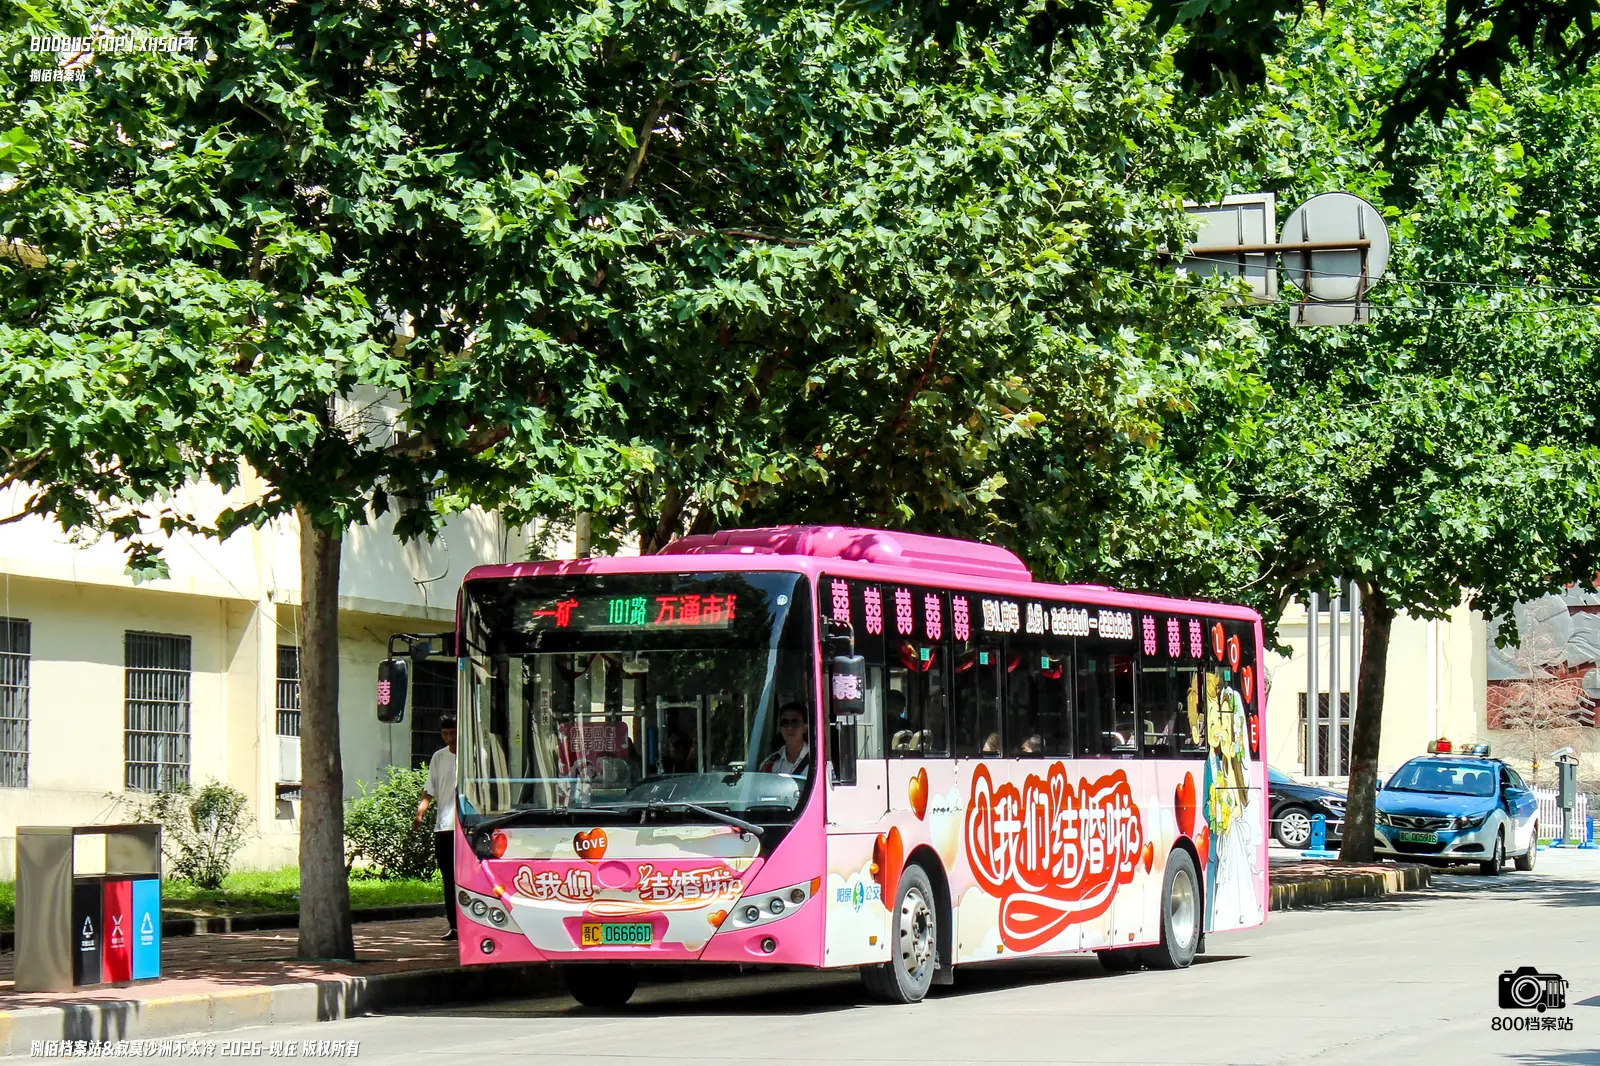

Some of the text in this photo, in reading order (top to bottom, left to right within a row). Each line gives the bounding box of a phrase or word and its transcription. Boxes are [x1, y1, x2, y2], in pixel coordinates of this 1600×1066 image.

[533, 597, 579, 627] 一矿
[608, 596, 647, 626] 101路
[575, 837, 606, 852] LOVE
[969, 773, 1140, 900] 我们结婚啦
[512, 864, 744, 901] 我们 结婚啦
[836, 885, 880, 903] 阳泉 公交
[583, 926, 651, 942] 晋C 06666D
